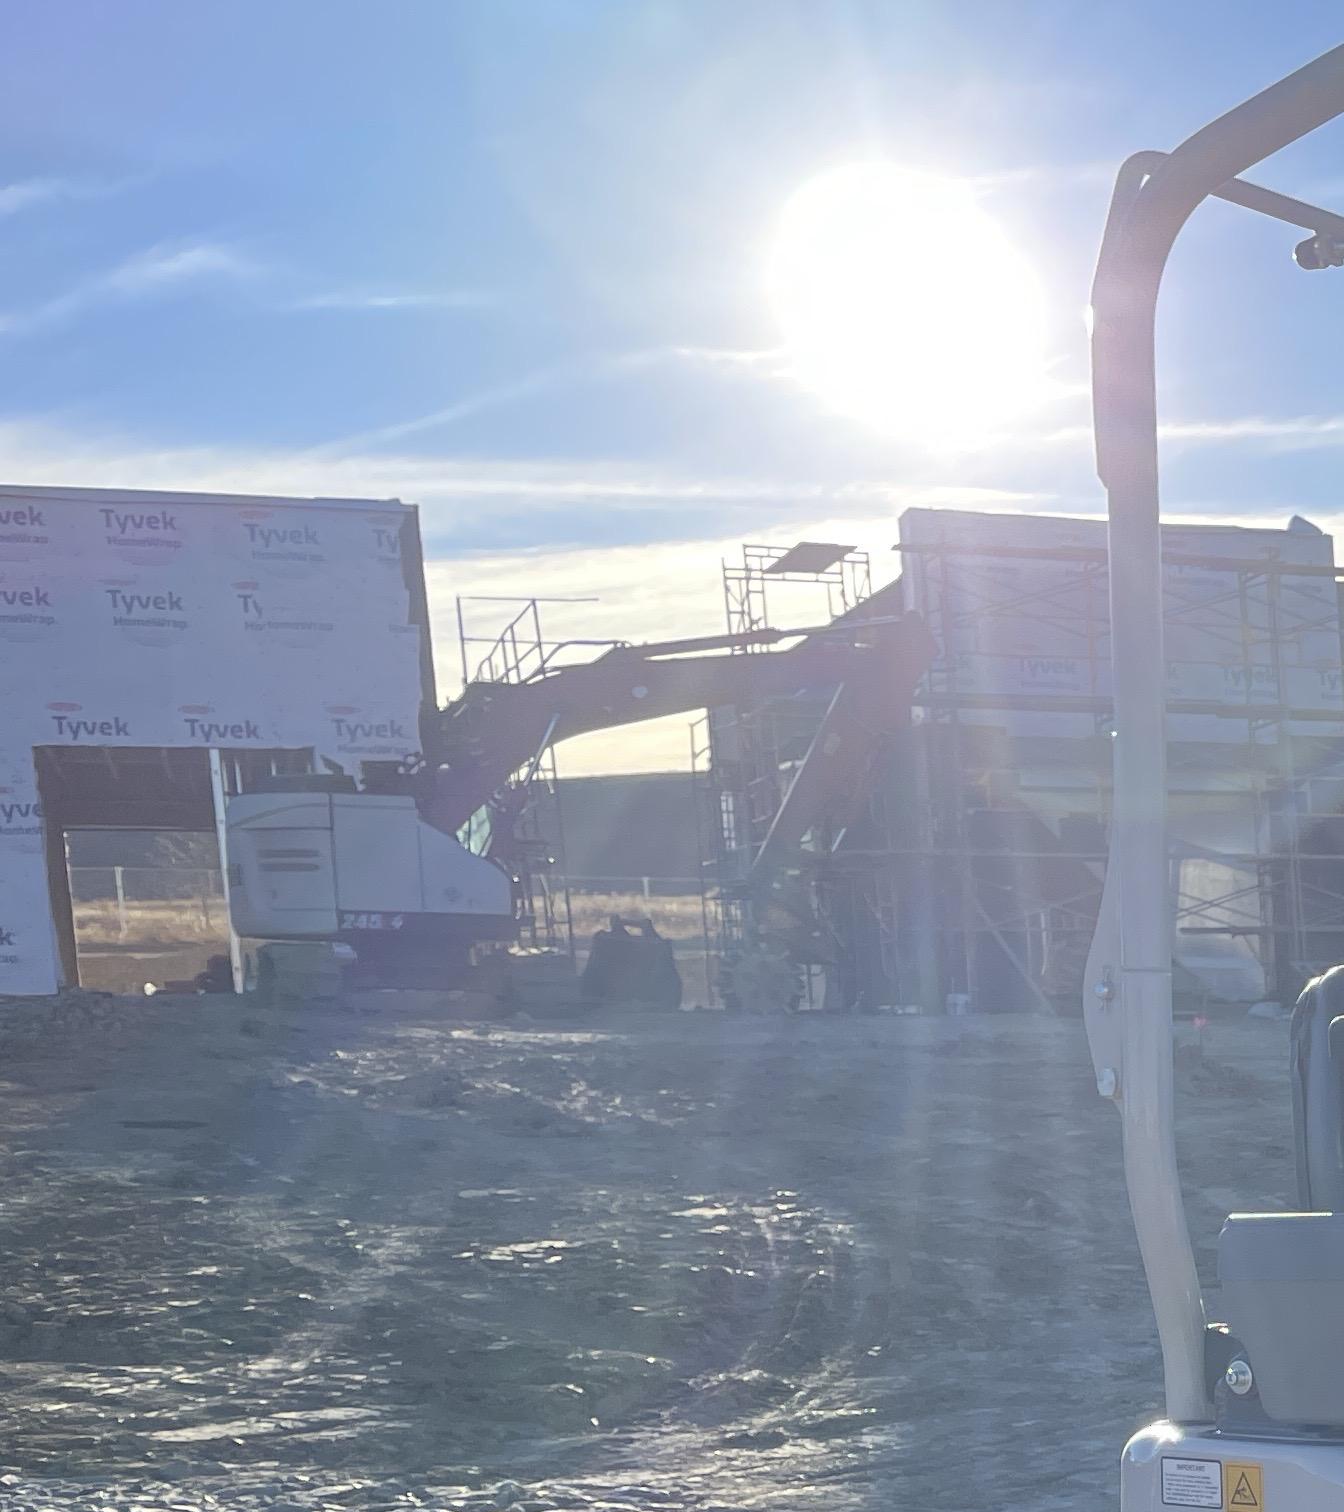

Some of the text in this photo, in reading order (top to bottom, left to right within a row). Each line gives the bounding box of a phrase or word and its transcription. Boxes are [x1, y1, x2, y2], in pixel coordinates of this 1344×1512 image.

[99, 509, 177, 534] Tyvek
[243, 523, 320, 548] Tyvek
[0, 586, 52, 607] vek
[105, 589, 184, 615] Tyvek
[51, 715, 131, 741] Tyvek
[184, 718, 261, 742] Tyvek
[331, 718, 404, 742] Tyvek
